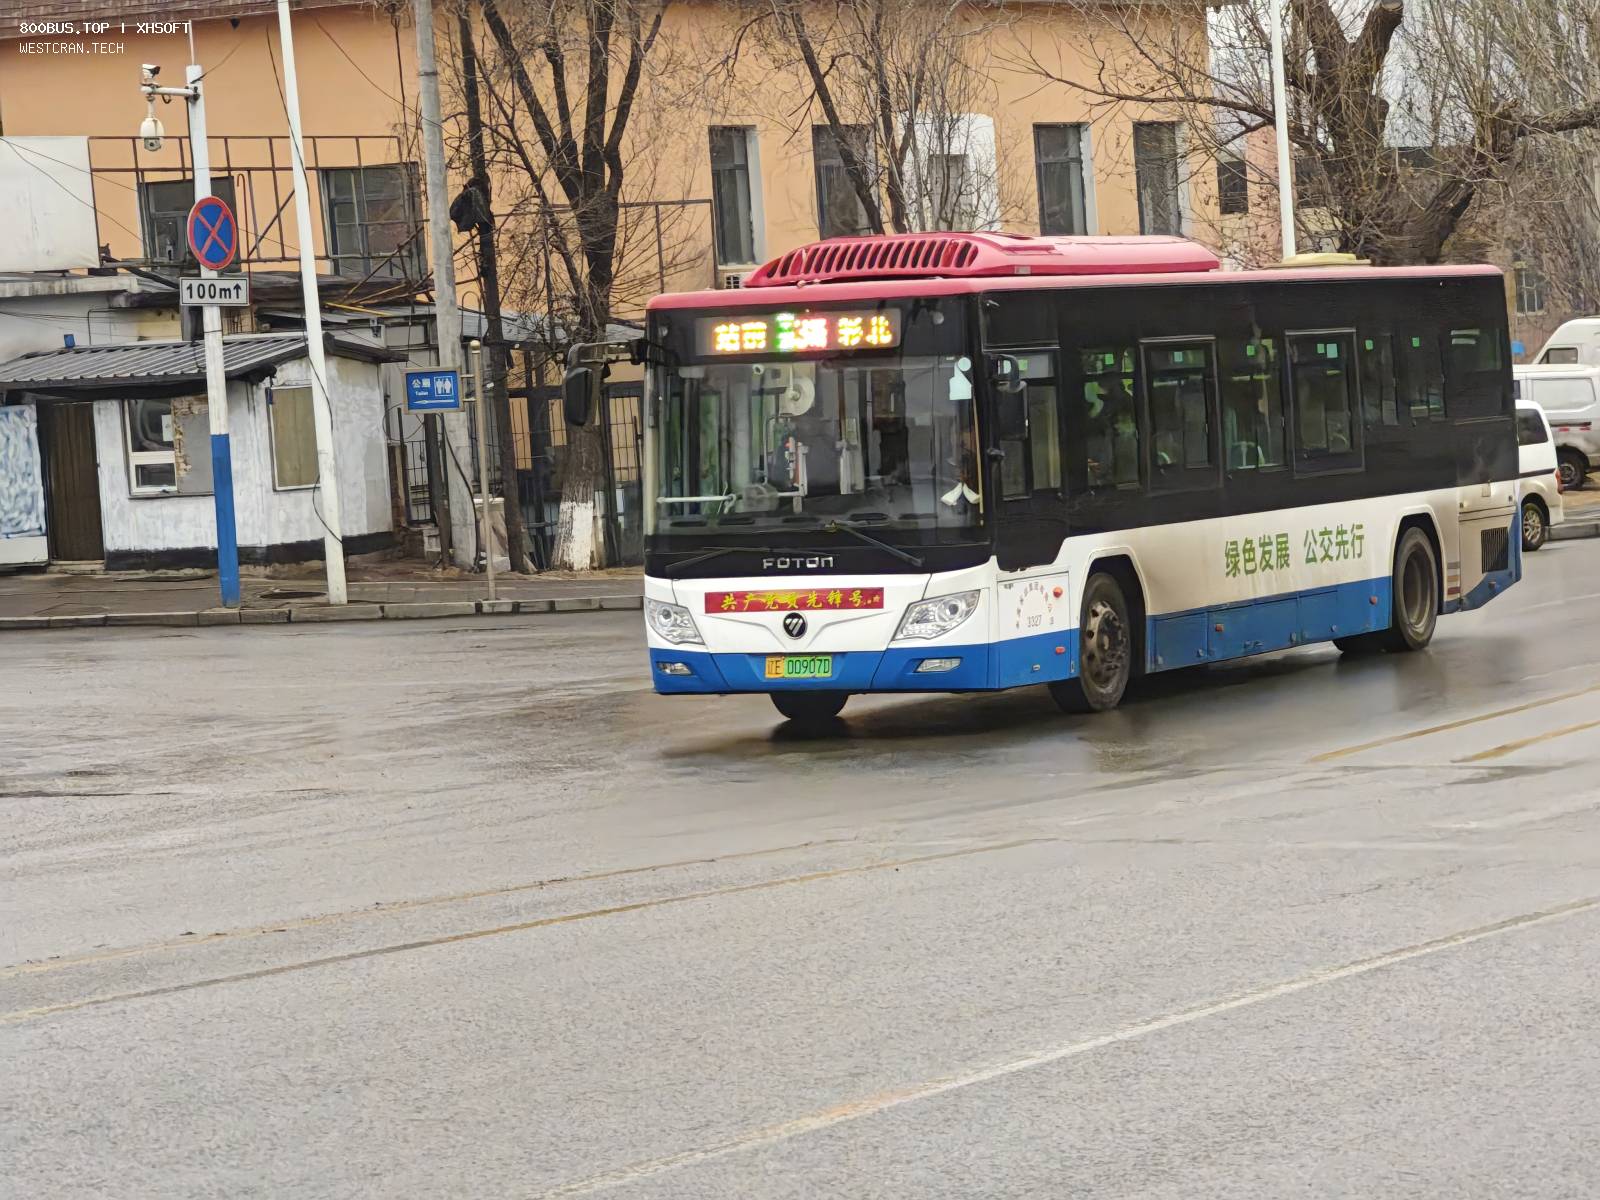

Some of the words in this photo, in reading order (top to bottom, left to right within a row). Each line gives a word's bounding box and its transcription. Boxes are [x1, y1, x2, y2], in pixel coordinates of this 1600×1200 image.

[186, 283, 231, 299] 100m
[1224, 532, 1291, 577] 绿色发展
[1303, 522, 1365, 565] 公交先行
[762, 556, 834, 570] FOTON
[720, 589, 863, 611] 共产党员先锋号
